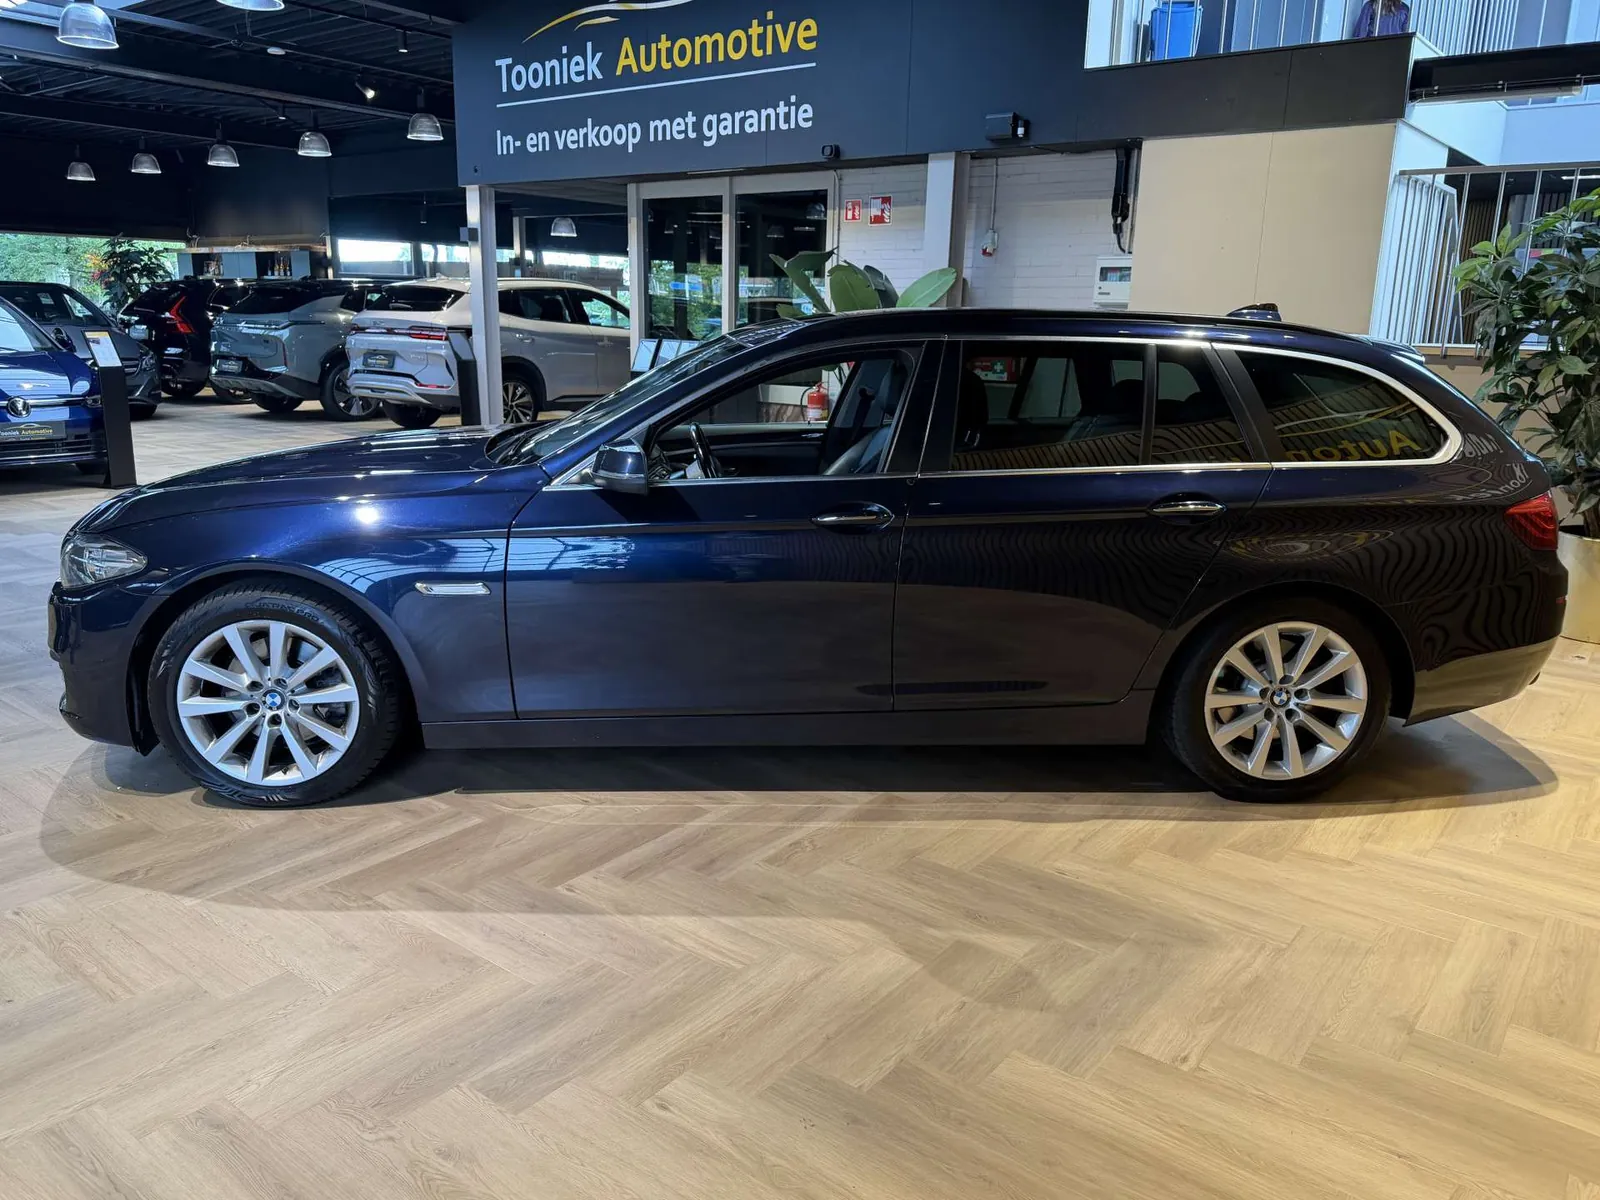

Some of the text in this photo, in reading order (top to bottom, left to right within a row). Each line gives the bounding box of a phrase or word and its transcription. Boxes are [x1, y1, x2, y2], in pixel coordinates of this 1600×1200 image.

[496, 11, 818, 92] Tooniek Automotive
[496, 95, 814, 155] In- en verkoop met garantie
